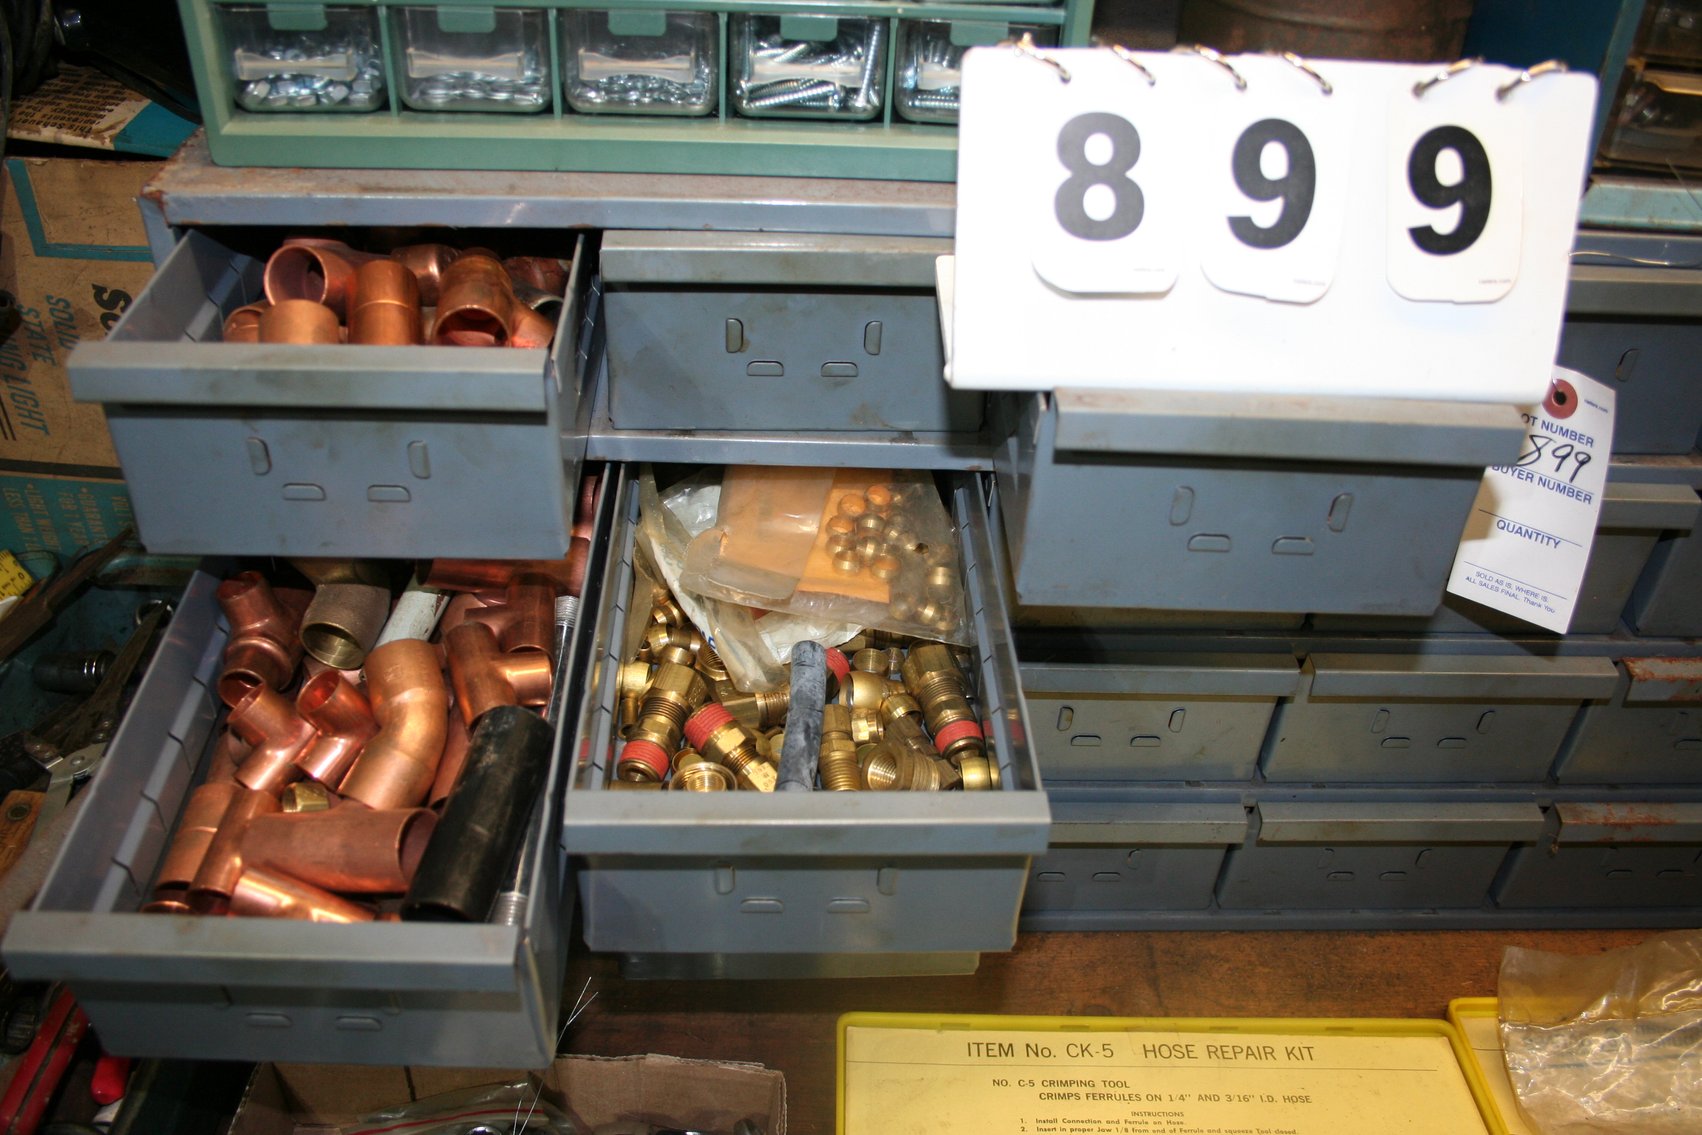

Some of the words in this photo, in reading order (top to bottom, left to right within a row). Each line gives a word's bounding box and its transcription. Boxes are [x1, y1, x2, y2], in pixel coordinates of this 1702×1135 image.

[16, 303, 57, 368] STATE
[3, 373, 50, 436] LIGHT
[1521, 413, 1538, 427] OT
[1541, 420, 1595, 448] NUMBER
[1516, 434, 1591, 483] 899
[1538, 476, 1593, 505] NUMBER
[1496, 519, 1561, 549] QUANTITY
[1465, 576, 1477, 584] ALL
[1479, 580, 1500, 593] SALES
[1475, 571, 1494, 582] SOLD
[1515, 585, 1540, 599] WHERE
[967, 1042, 1015, 1058] ITEM
[1025, 1043, 1057, 1058] No.
[1066, 1043, 1114, 1059] CK-5
[1142, 1044, 1198, 1060] HOSE
[1206, 1044, 1277, 1061] REPAIR
[1285, 1046, 1314, 1061] KIT
[992, 1079, 1011, 1088] NO.
[1018, 1079, 1035, 1088] C-5
[1041, 1079, 1096, 1088] CRIMPING
[1102, 1080, 1130, 1089] TOOL
[1039, 1092, 1081, 1101] CRIMPS
[1085, 1092, 1142, 1102] FERRULES
[1146, 1093, 1162, 1102] ON
[1198, 1094, 1221, 1102] AND
[1260, 1095, 1278, 1103] I.D.
[1283, 1095, 1313, 1104] HOSE
